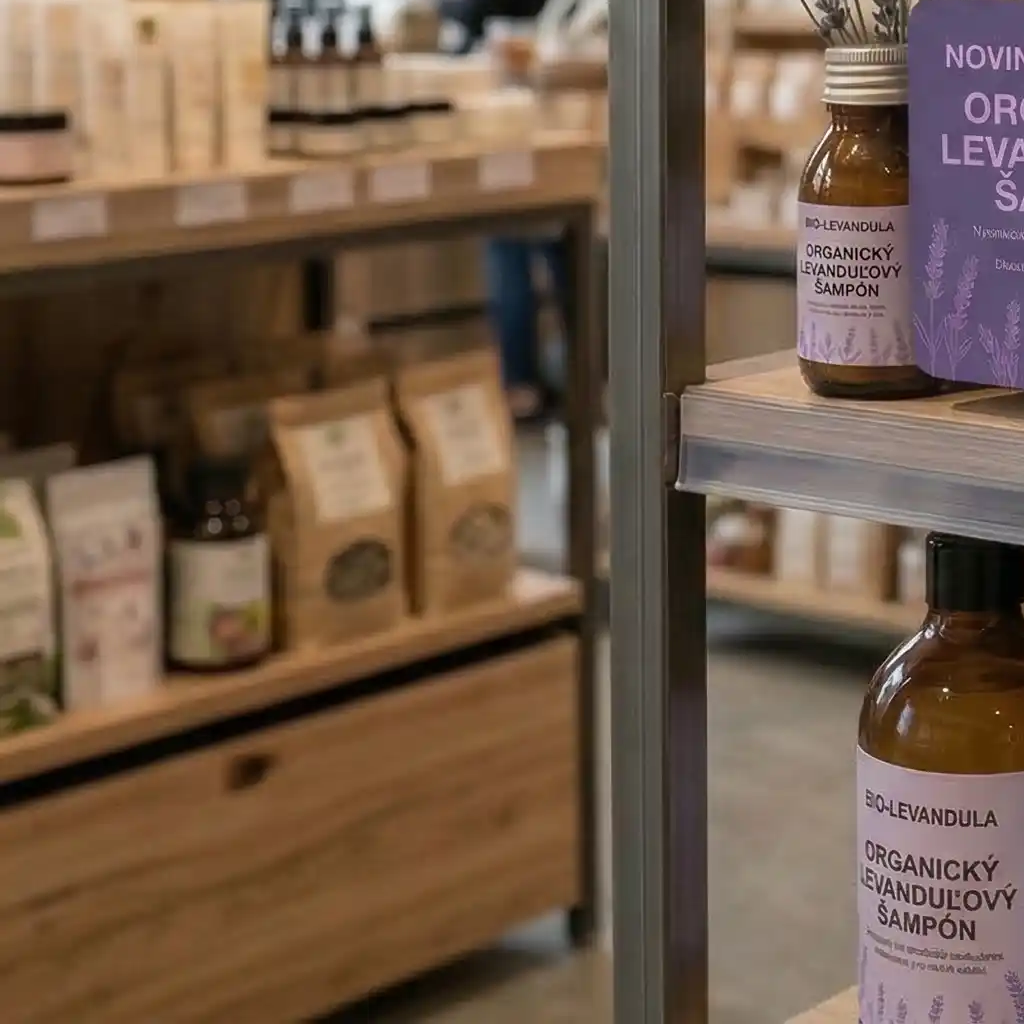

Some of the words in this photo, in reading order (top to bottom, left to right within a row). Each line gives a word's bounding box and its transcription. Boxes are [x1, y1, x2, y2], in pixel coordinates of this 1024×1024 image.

[800, 260, 902, 279] LEVANDUĽOVÝ
[805, 242, 895, 261] ORGANICKÝ
[814, 277, 880, 297] ŠAMPÓN
[864, 787, 999, 828] BIO-LEVANDULA
[864, 838, 1000, 883] ORGANICKÝ
[860, 862, 1018, 912] LEVANDUĽOVÝ
[877, 898, 976, 942] ŠAMPÓN
